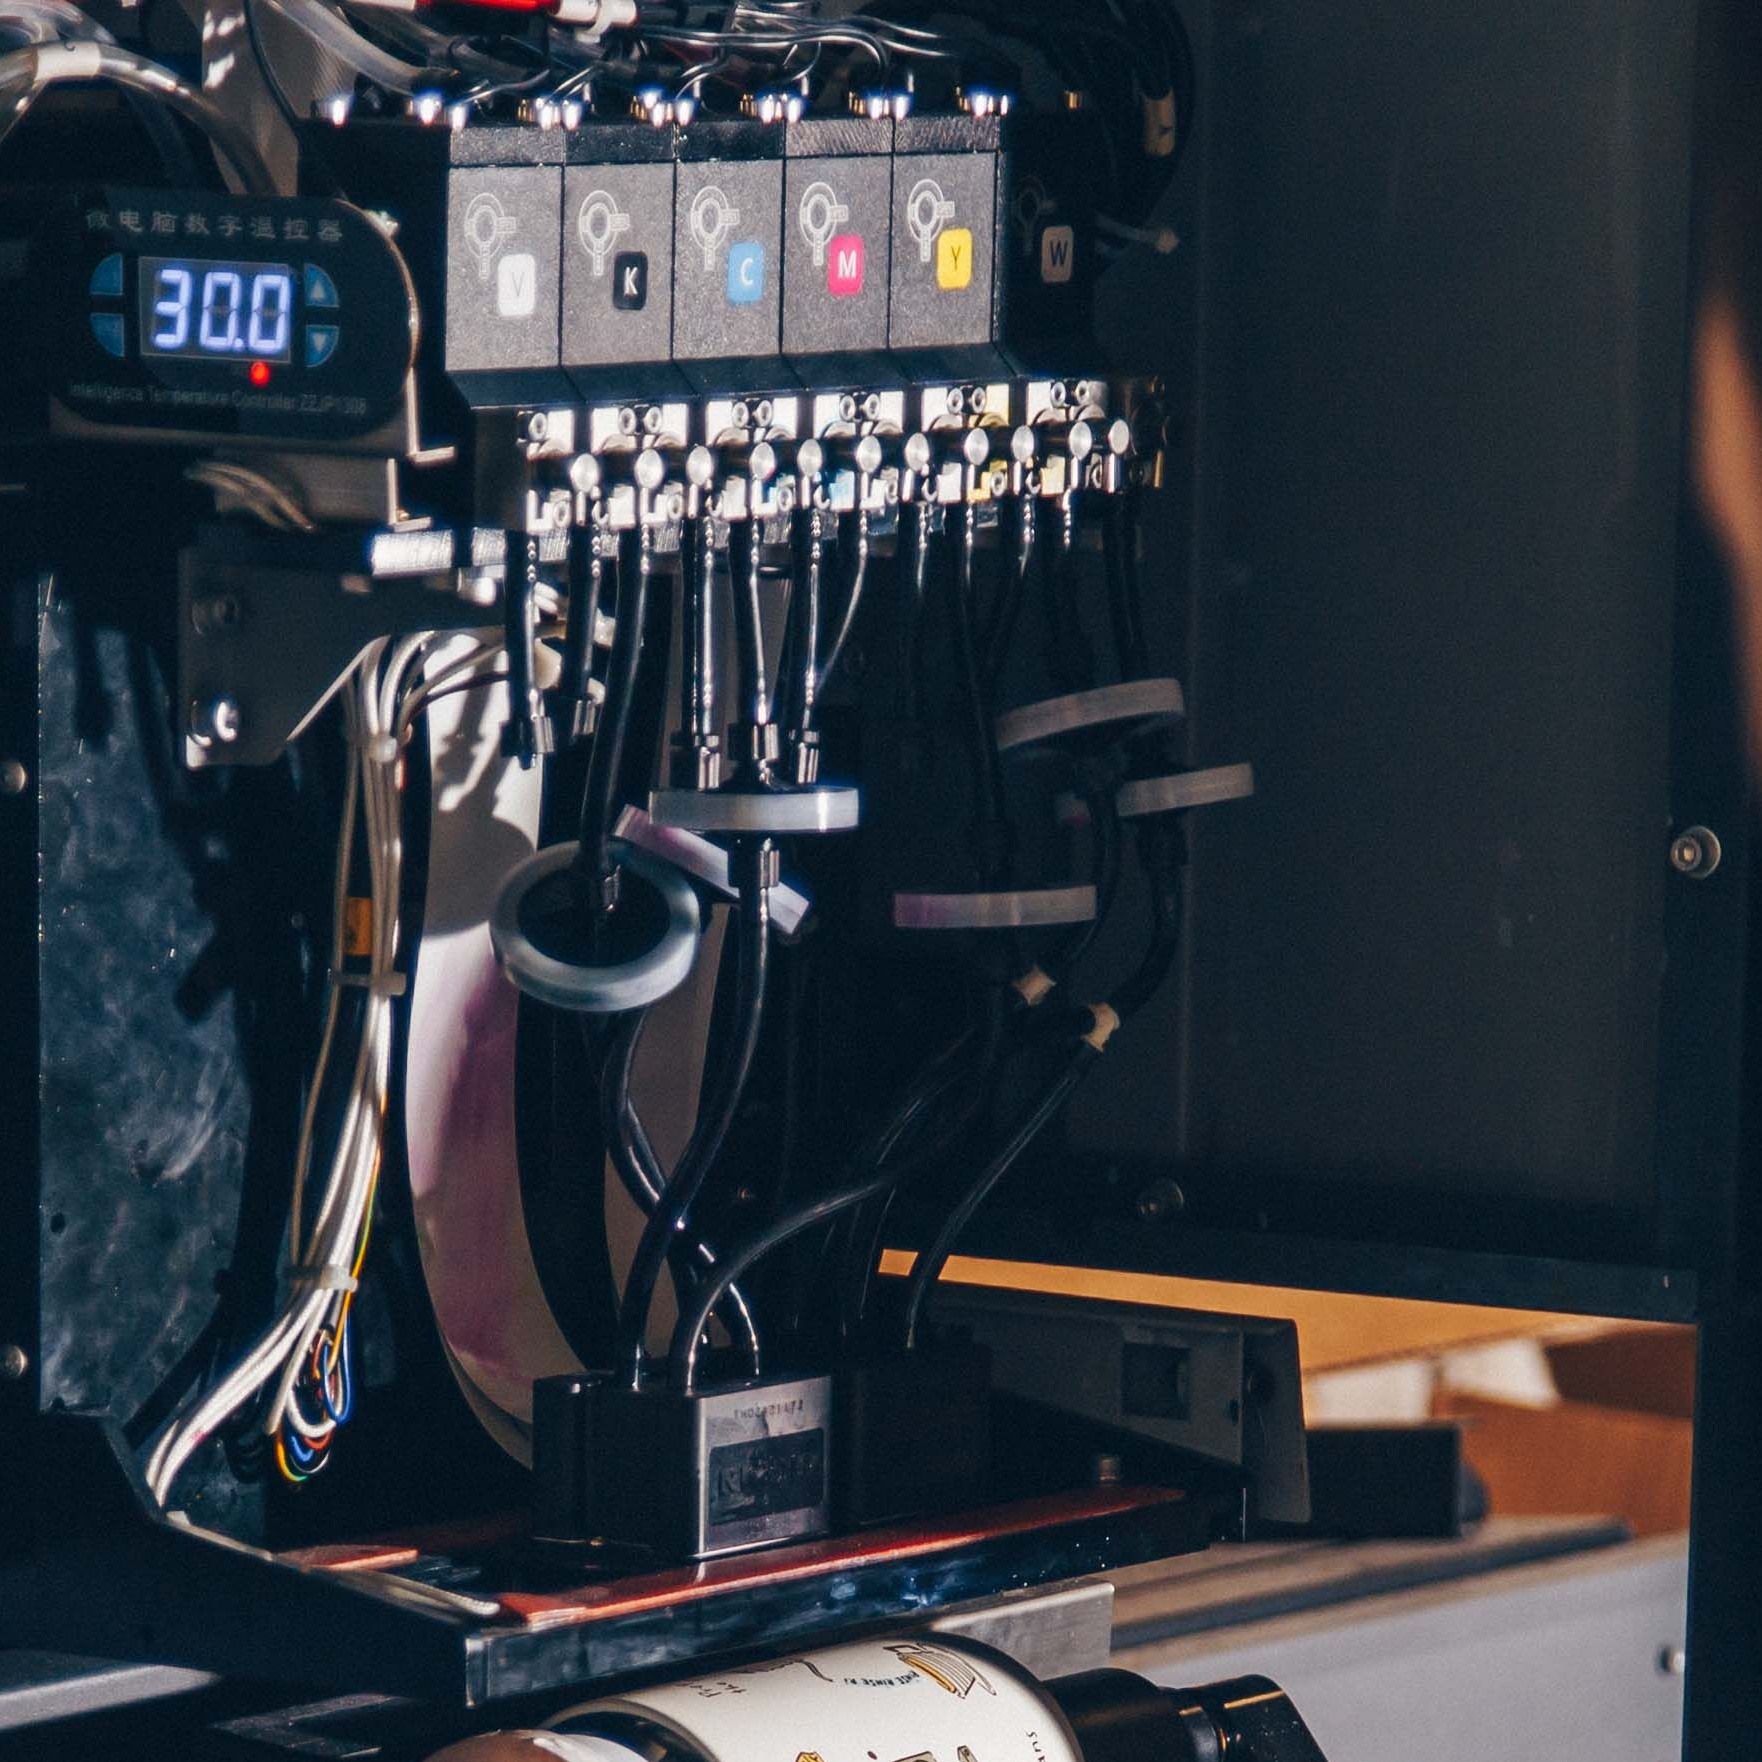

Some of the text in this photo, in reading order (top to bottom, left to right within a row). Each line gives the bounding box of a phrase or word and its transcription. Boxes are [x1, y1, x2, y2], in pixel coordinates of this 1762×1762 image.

[838, 250, 857, 279] M
[950, 245, 962, 271] Y
[1049, 240, 1069, 267] W
[510, 271, 525, 299] V
[623, 265, 639, 297] K
[740, 256, 754, 287] C
[153, 268, 293, 355] 30.0
